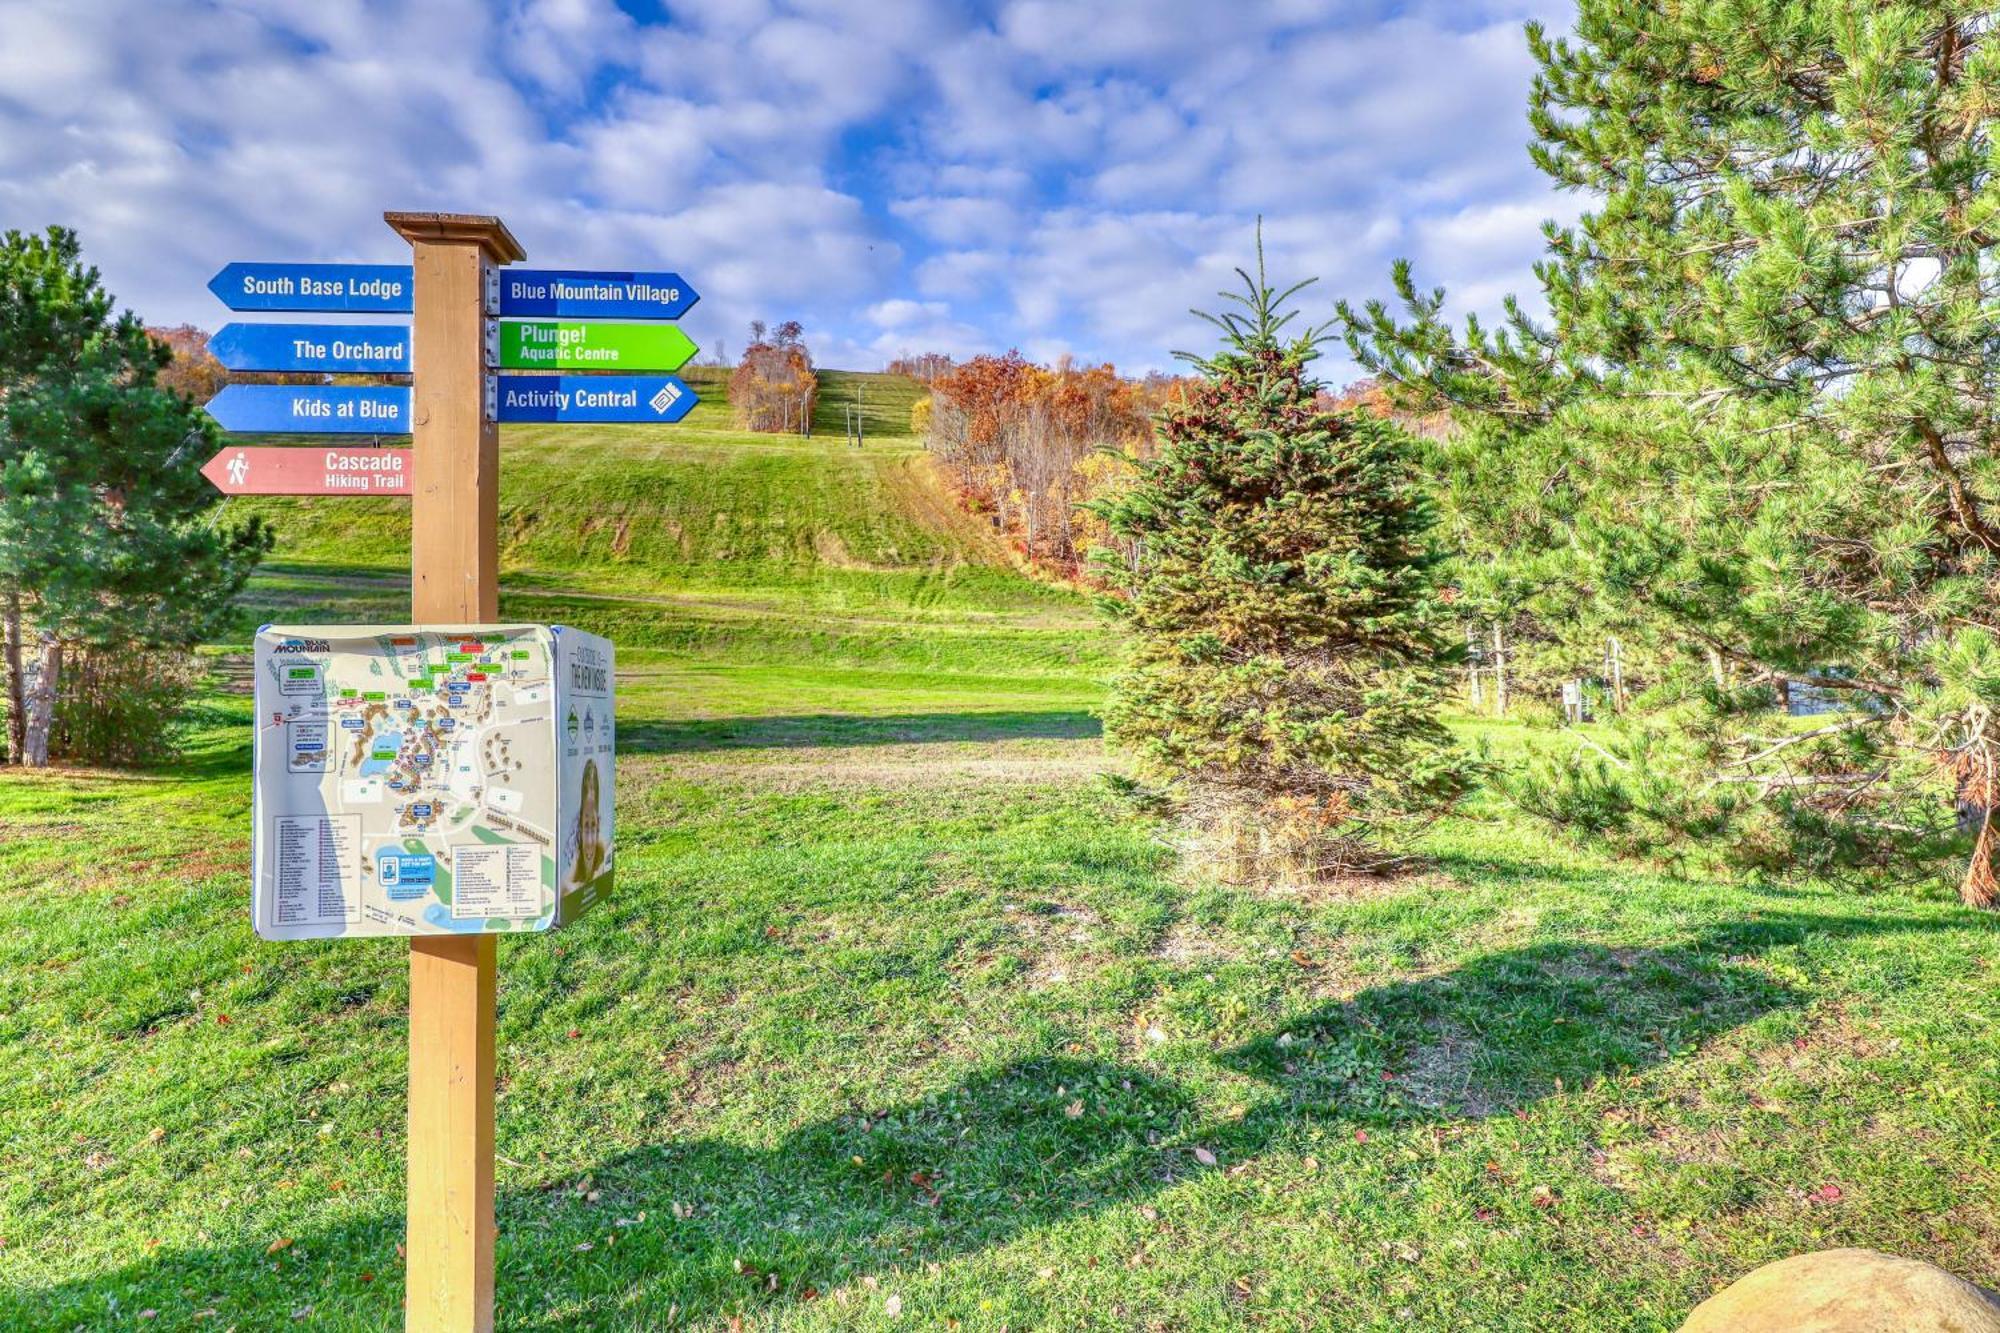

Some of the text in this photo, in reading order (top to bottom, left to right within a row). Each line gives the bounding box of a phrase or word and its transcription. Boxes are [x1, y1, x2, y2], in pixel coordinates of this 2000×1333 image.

[243, 276, 402, 300] South Base Lodge
[511, 282, 680, 305] Blue Mountain Village
[520, 324, 587, 347] Plunge!
[293, 340, 403, 360] The Orchard
[520, 346, 619, 361] Aquatic Centre
[292, 398, 399, 418] Kids at Blue
[505, 389, 637, 411] Activity Central
[325, 451, 403, 471] Cascade
[325, 473, 404, 490] Hiking Trail
[273, 644, 330, 654] MOUNTAIN
